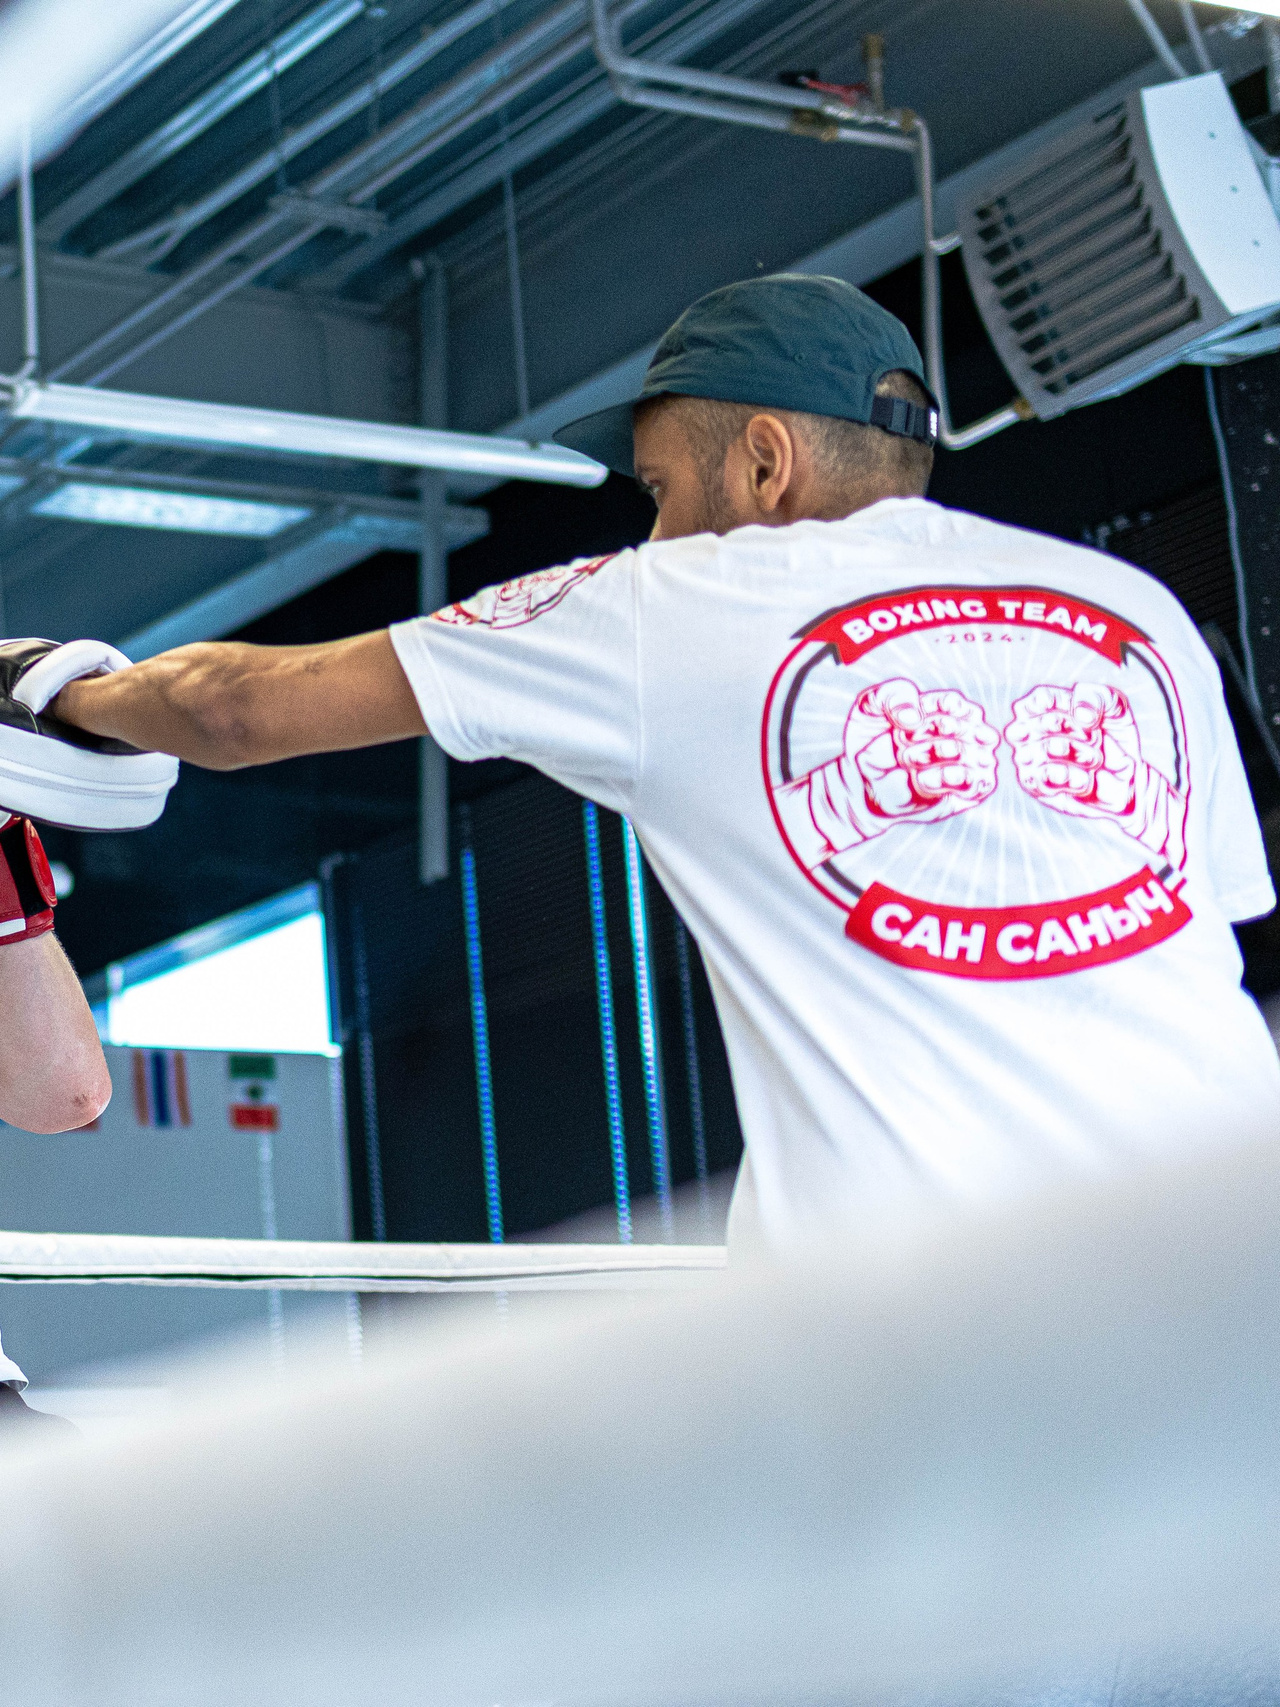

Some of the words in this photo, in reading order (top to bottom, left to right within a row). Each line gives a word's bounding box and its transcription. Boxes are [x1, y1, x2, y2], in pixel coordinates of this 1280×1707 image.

[842, 599, 987, 644] BOXING
[998, 600, 1108, 643] TEAM
[946, 632, 1013, 644] 2024
[871, 902, 987, 964] САН
[996, 879, 1175, 965] САНЫЧ
